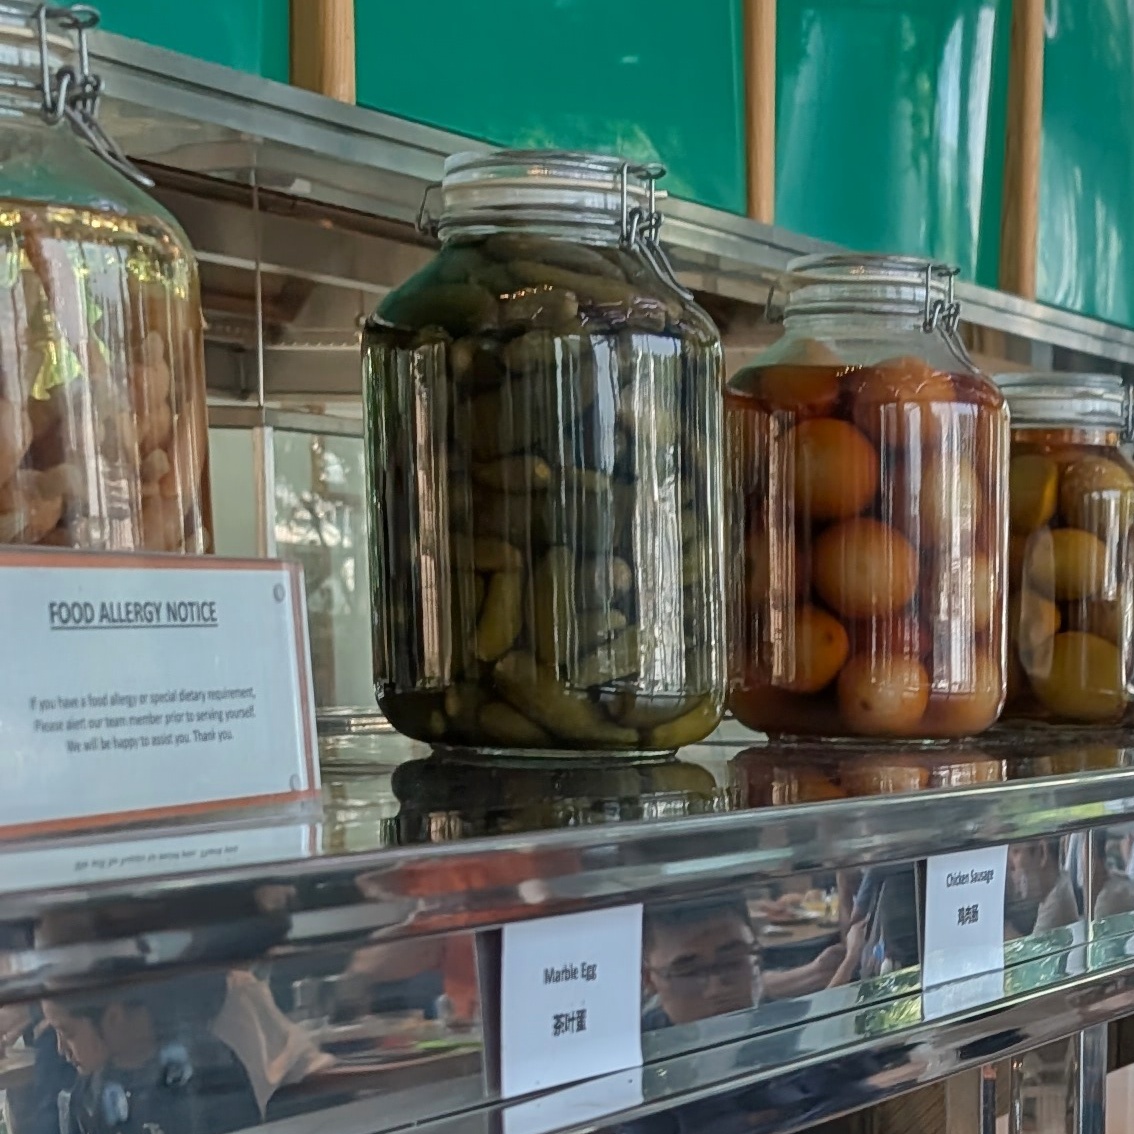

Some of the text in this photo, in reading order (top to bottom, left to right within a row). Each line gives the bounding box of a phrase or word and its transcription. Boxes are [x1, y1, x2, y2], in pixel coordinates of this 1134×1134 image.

[50, 601, 218, 625] FOOD ALLERGY NOTICE
[40, 698, 56, 713] you
[57, 695, 79, 710] have
[87, 692, 108, 708] food
[110, 691, 138, 709] allergy
[139, 693, 148, 705] or
[150, 690, 177, 706] special
[179, 689, 205, 703] dietary
[34, 718, 64, 732] Please
[66, 717, 86, 731] alert
[104, 717, 126, 729] team
[128, 713, 163, 726] member
[165, 711, 184, 725] prior
[185, 711, 195, 723] to
[196, 709, 223, 723] serving
[66, 740, 80, 753] We
[83, 737, 97, 751] will
[100, 736, 110, 750] be
[112, 736, 138, 751] happy
[139, 735, 150, 748] to
[151, 733, 172, 747] assist
[192, 729, 216, 743] Thank
[946, 868, 994, 888] Chicken Sausage
[543, 961, 597, 984] Marble Egg
[553, 1008, 587, 1037] 茶叶蛋
